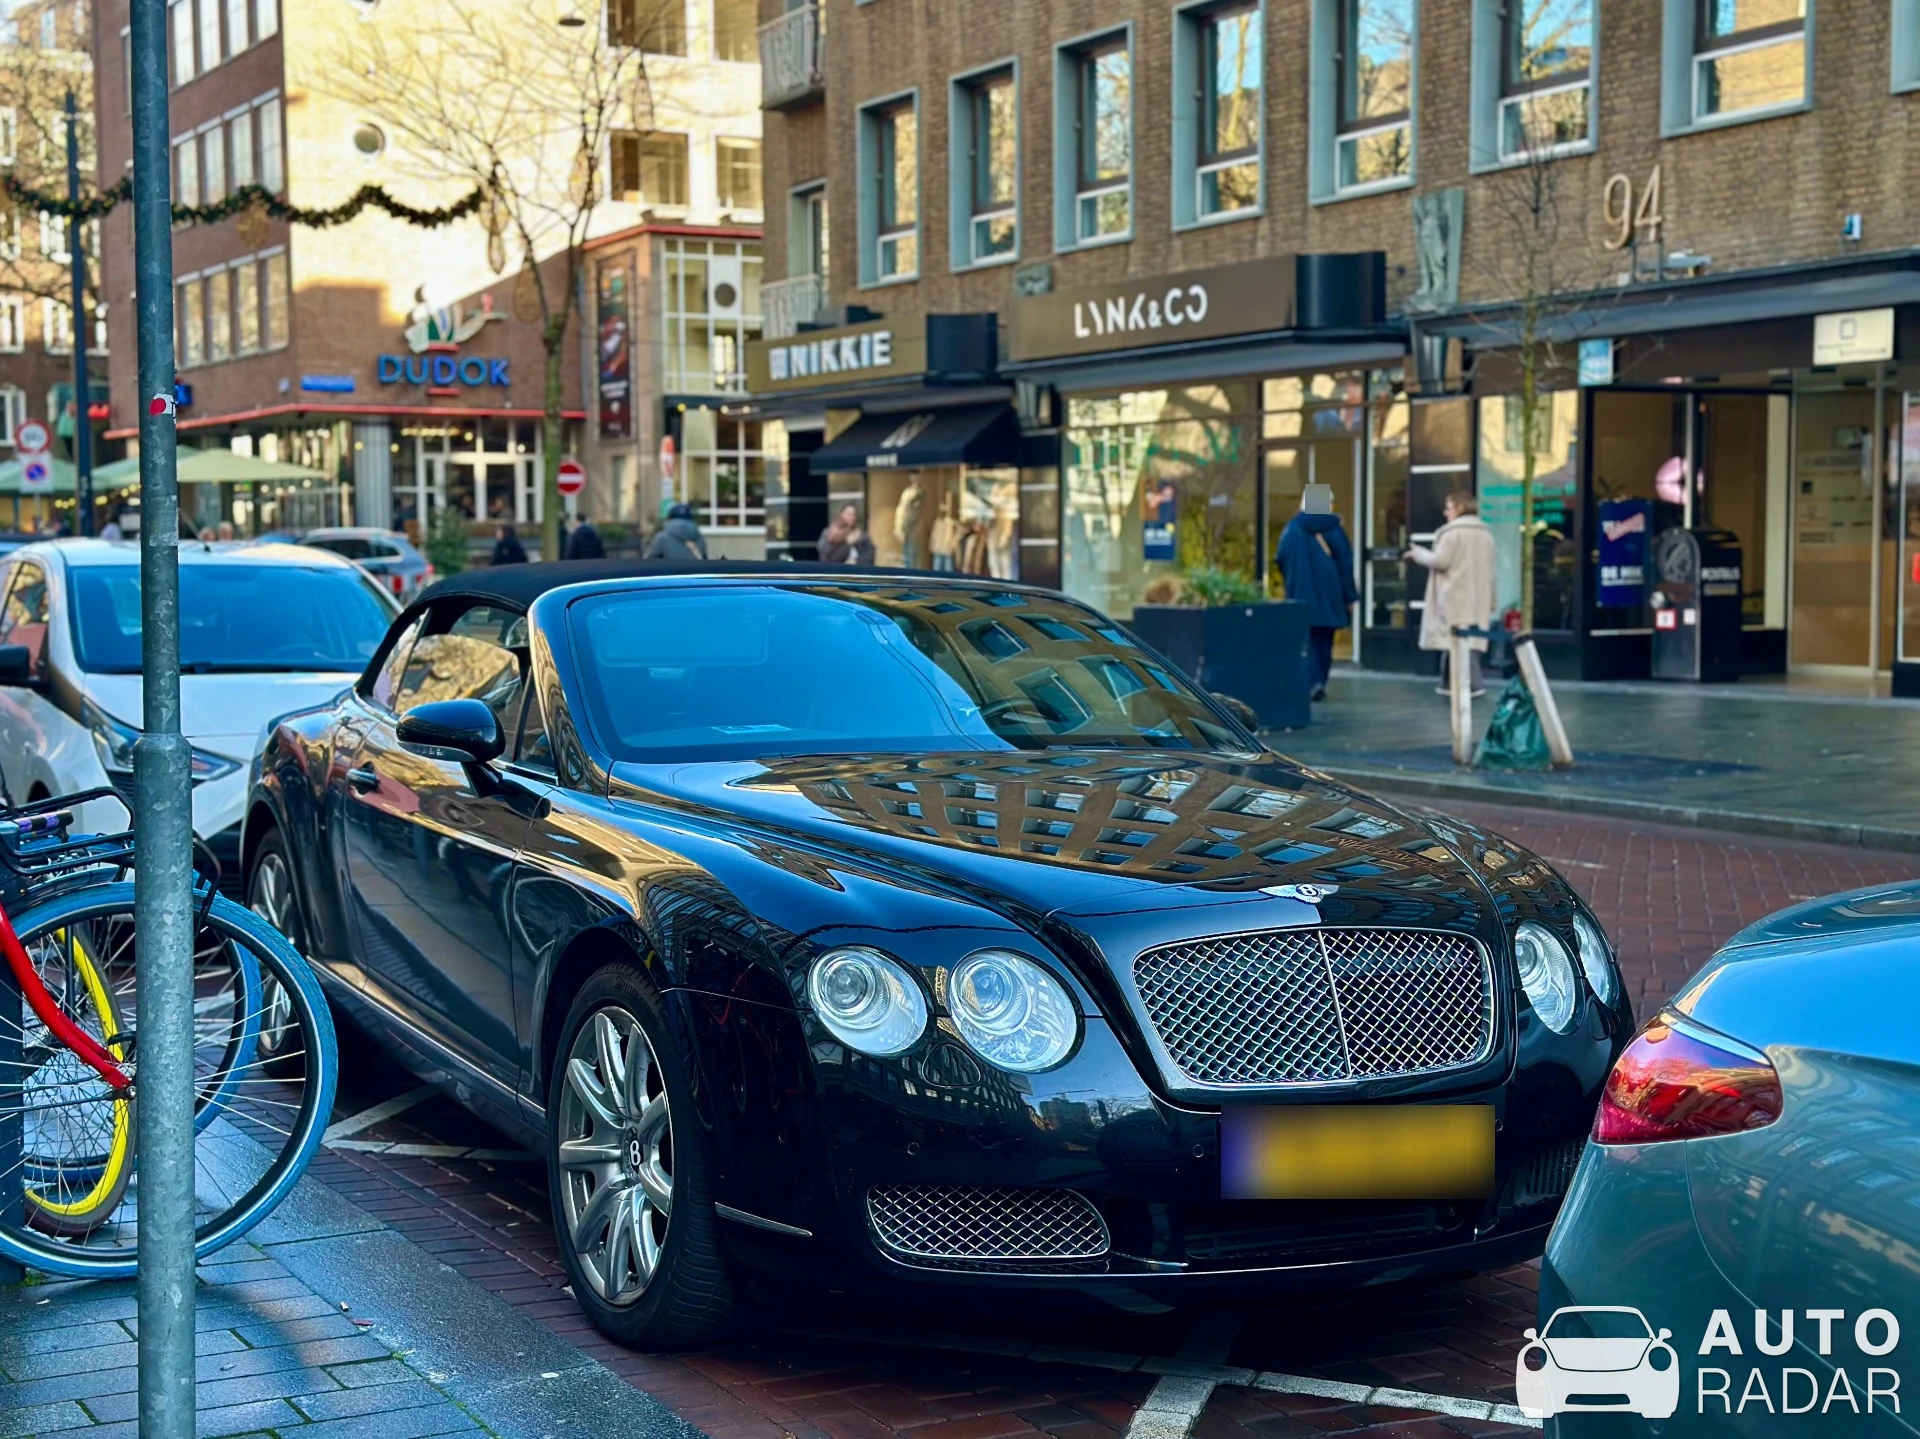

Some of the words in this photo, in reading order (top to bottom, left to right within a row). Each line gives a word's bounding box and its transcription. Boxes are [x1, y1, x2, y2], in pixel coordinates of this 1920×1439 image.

[1604, 164, 1662, 249] 94
[377, 354, 511, 387] DUDOK
[789, 330, 892, 378] NIKKIE
